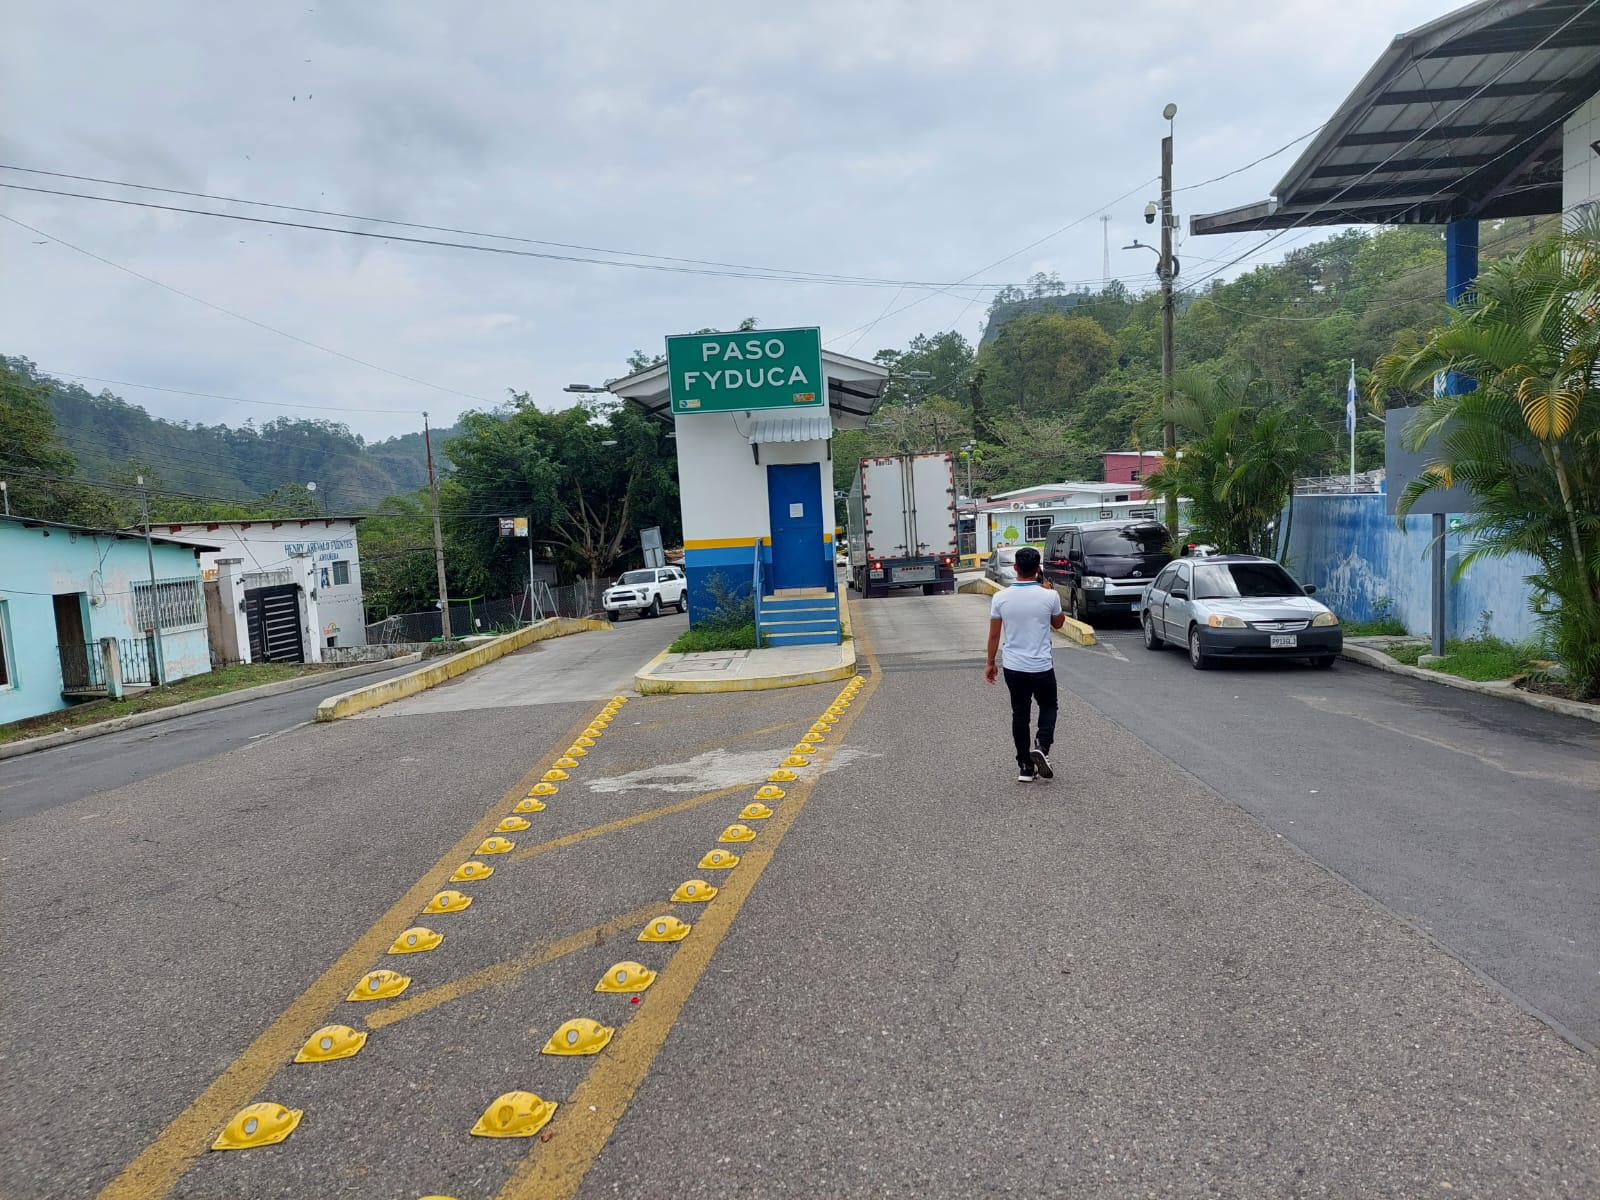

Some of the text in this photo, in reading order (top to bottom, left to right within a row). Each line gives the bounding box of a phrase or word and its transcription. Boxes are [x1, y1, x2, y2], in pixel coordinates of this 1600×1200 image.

[702, 339, 785, 362] PASO
[684, 365, 809, 391] FYDUCA
[284, 543, 304, 555] HENRY
